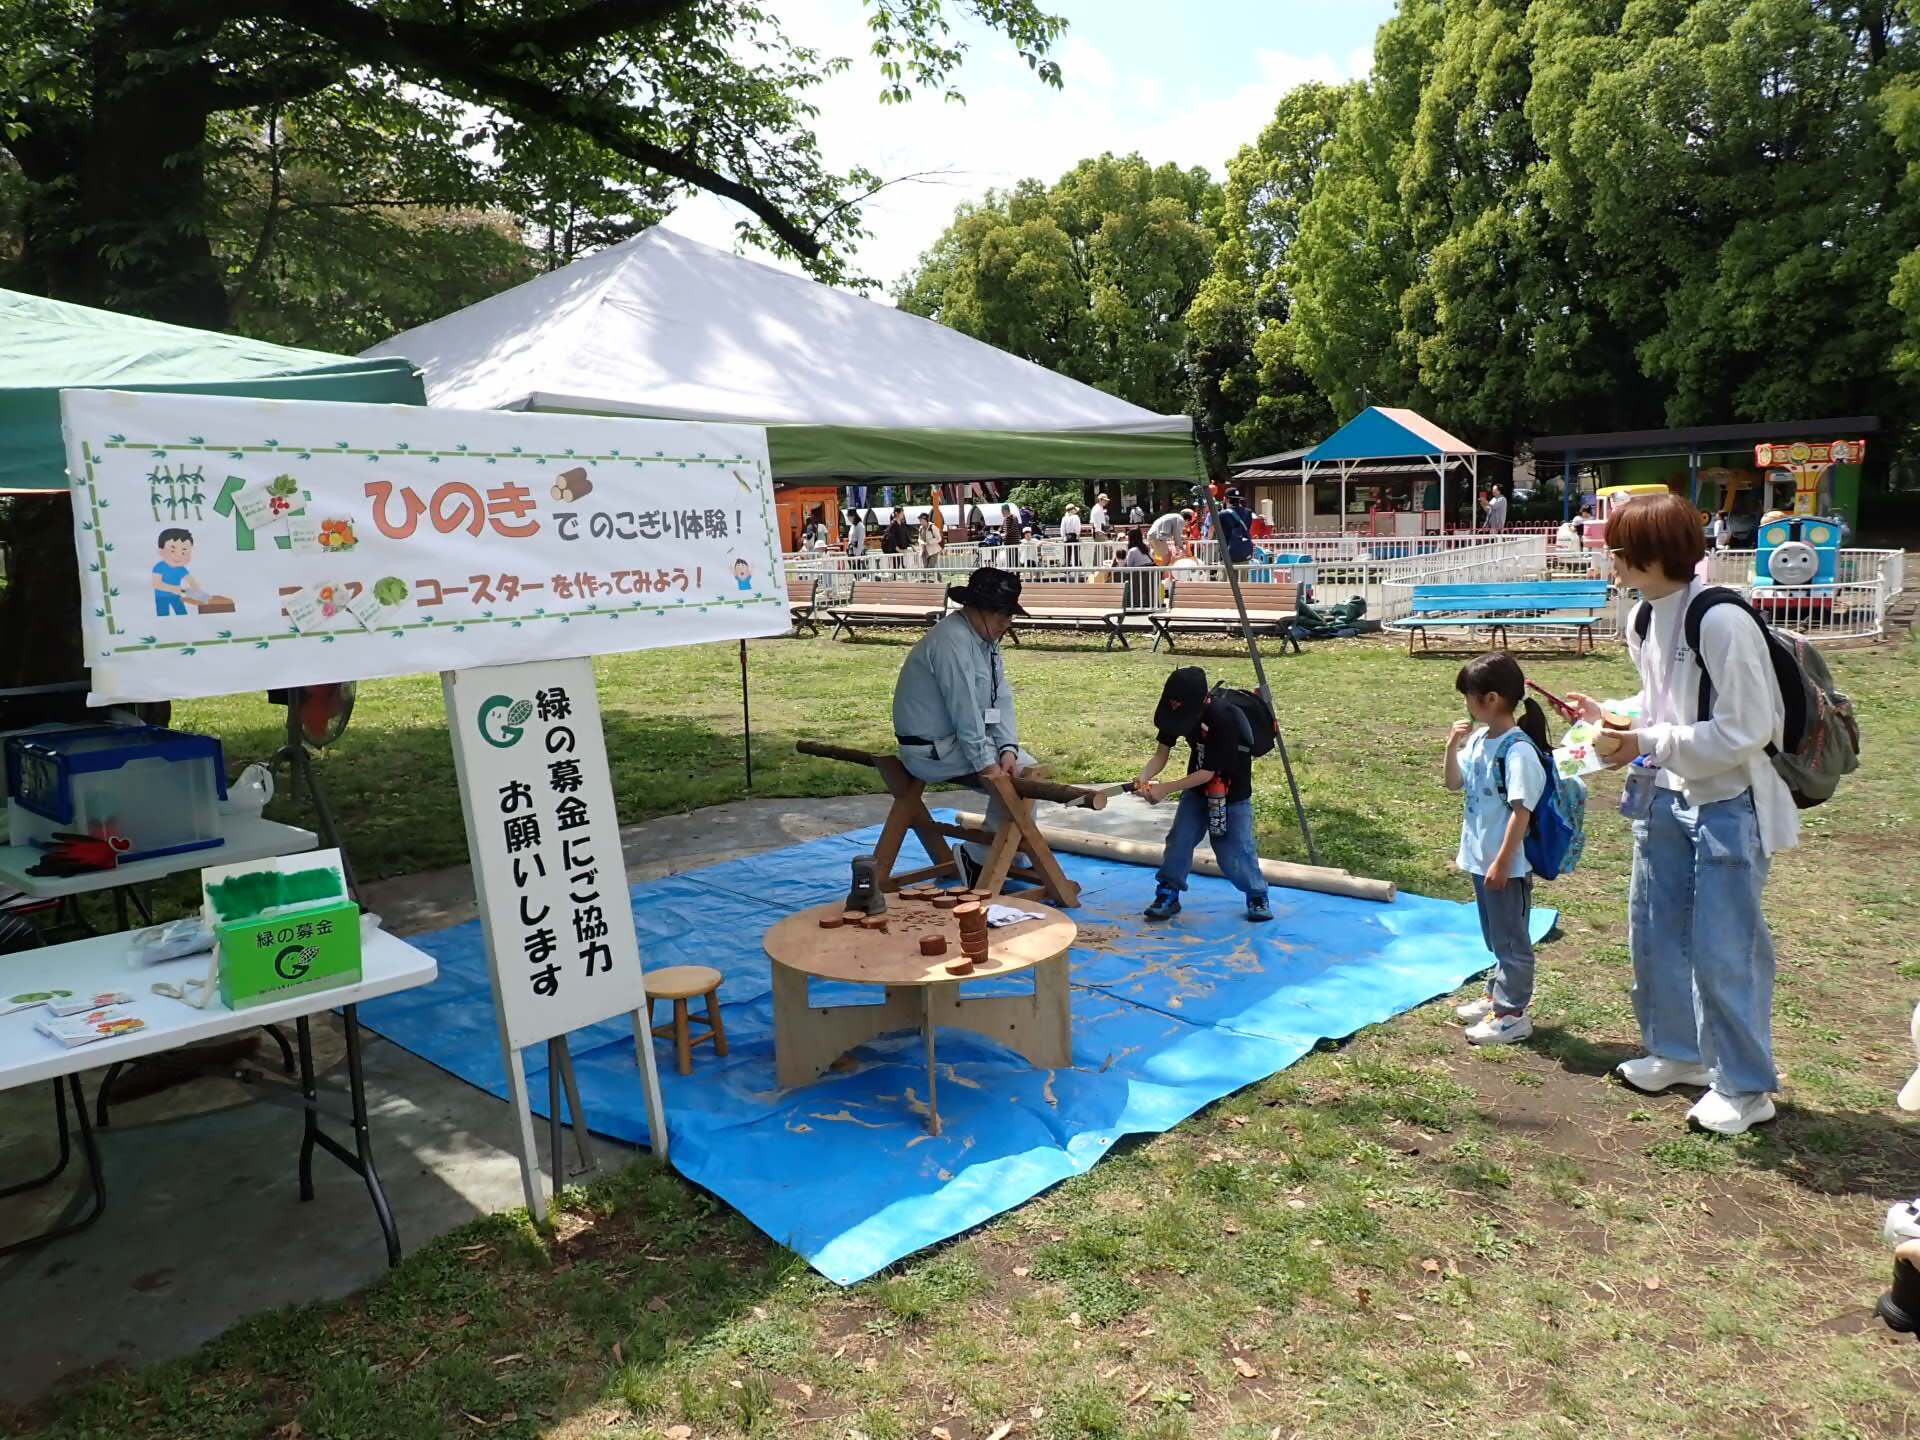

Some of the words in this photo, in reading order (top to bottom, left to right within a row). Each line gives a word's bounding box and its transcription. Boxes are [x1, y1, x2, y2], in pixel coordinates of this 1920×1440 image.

[364, 480, 541, 540] ひのき
[498, 779, 563, 997] お願いします
[534, 686, 613, 977] 緑の募金にご協力
[256, 919, 333, 949] 緑の募金
